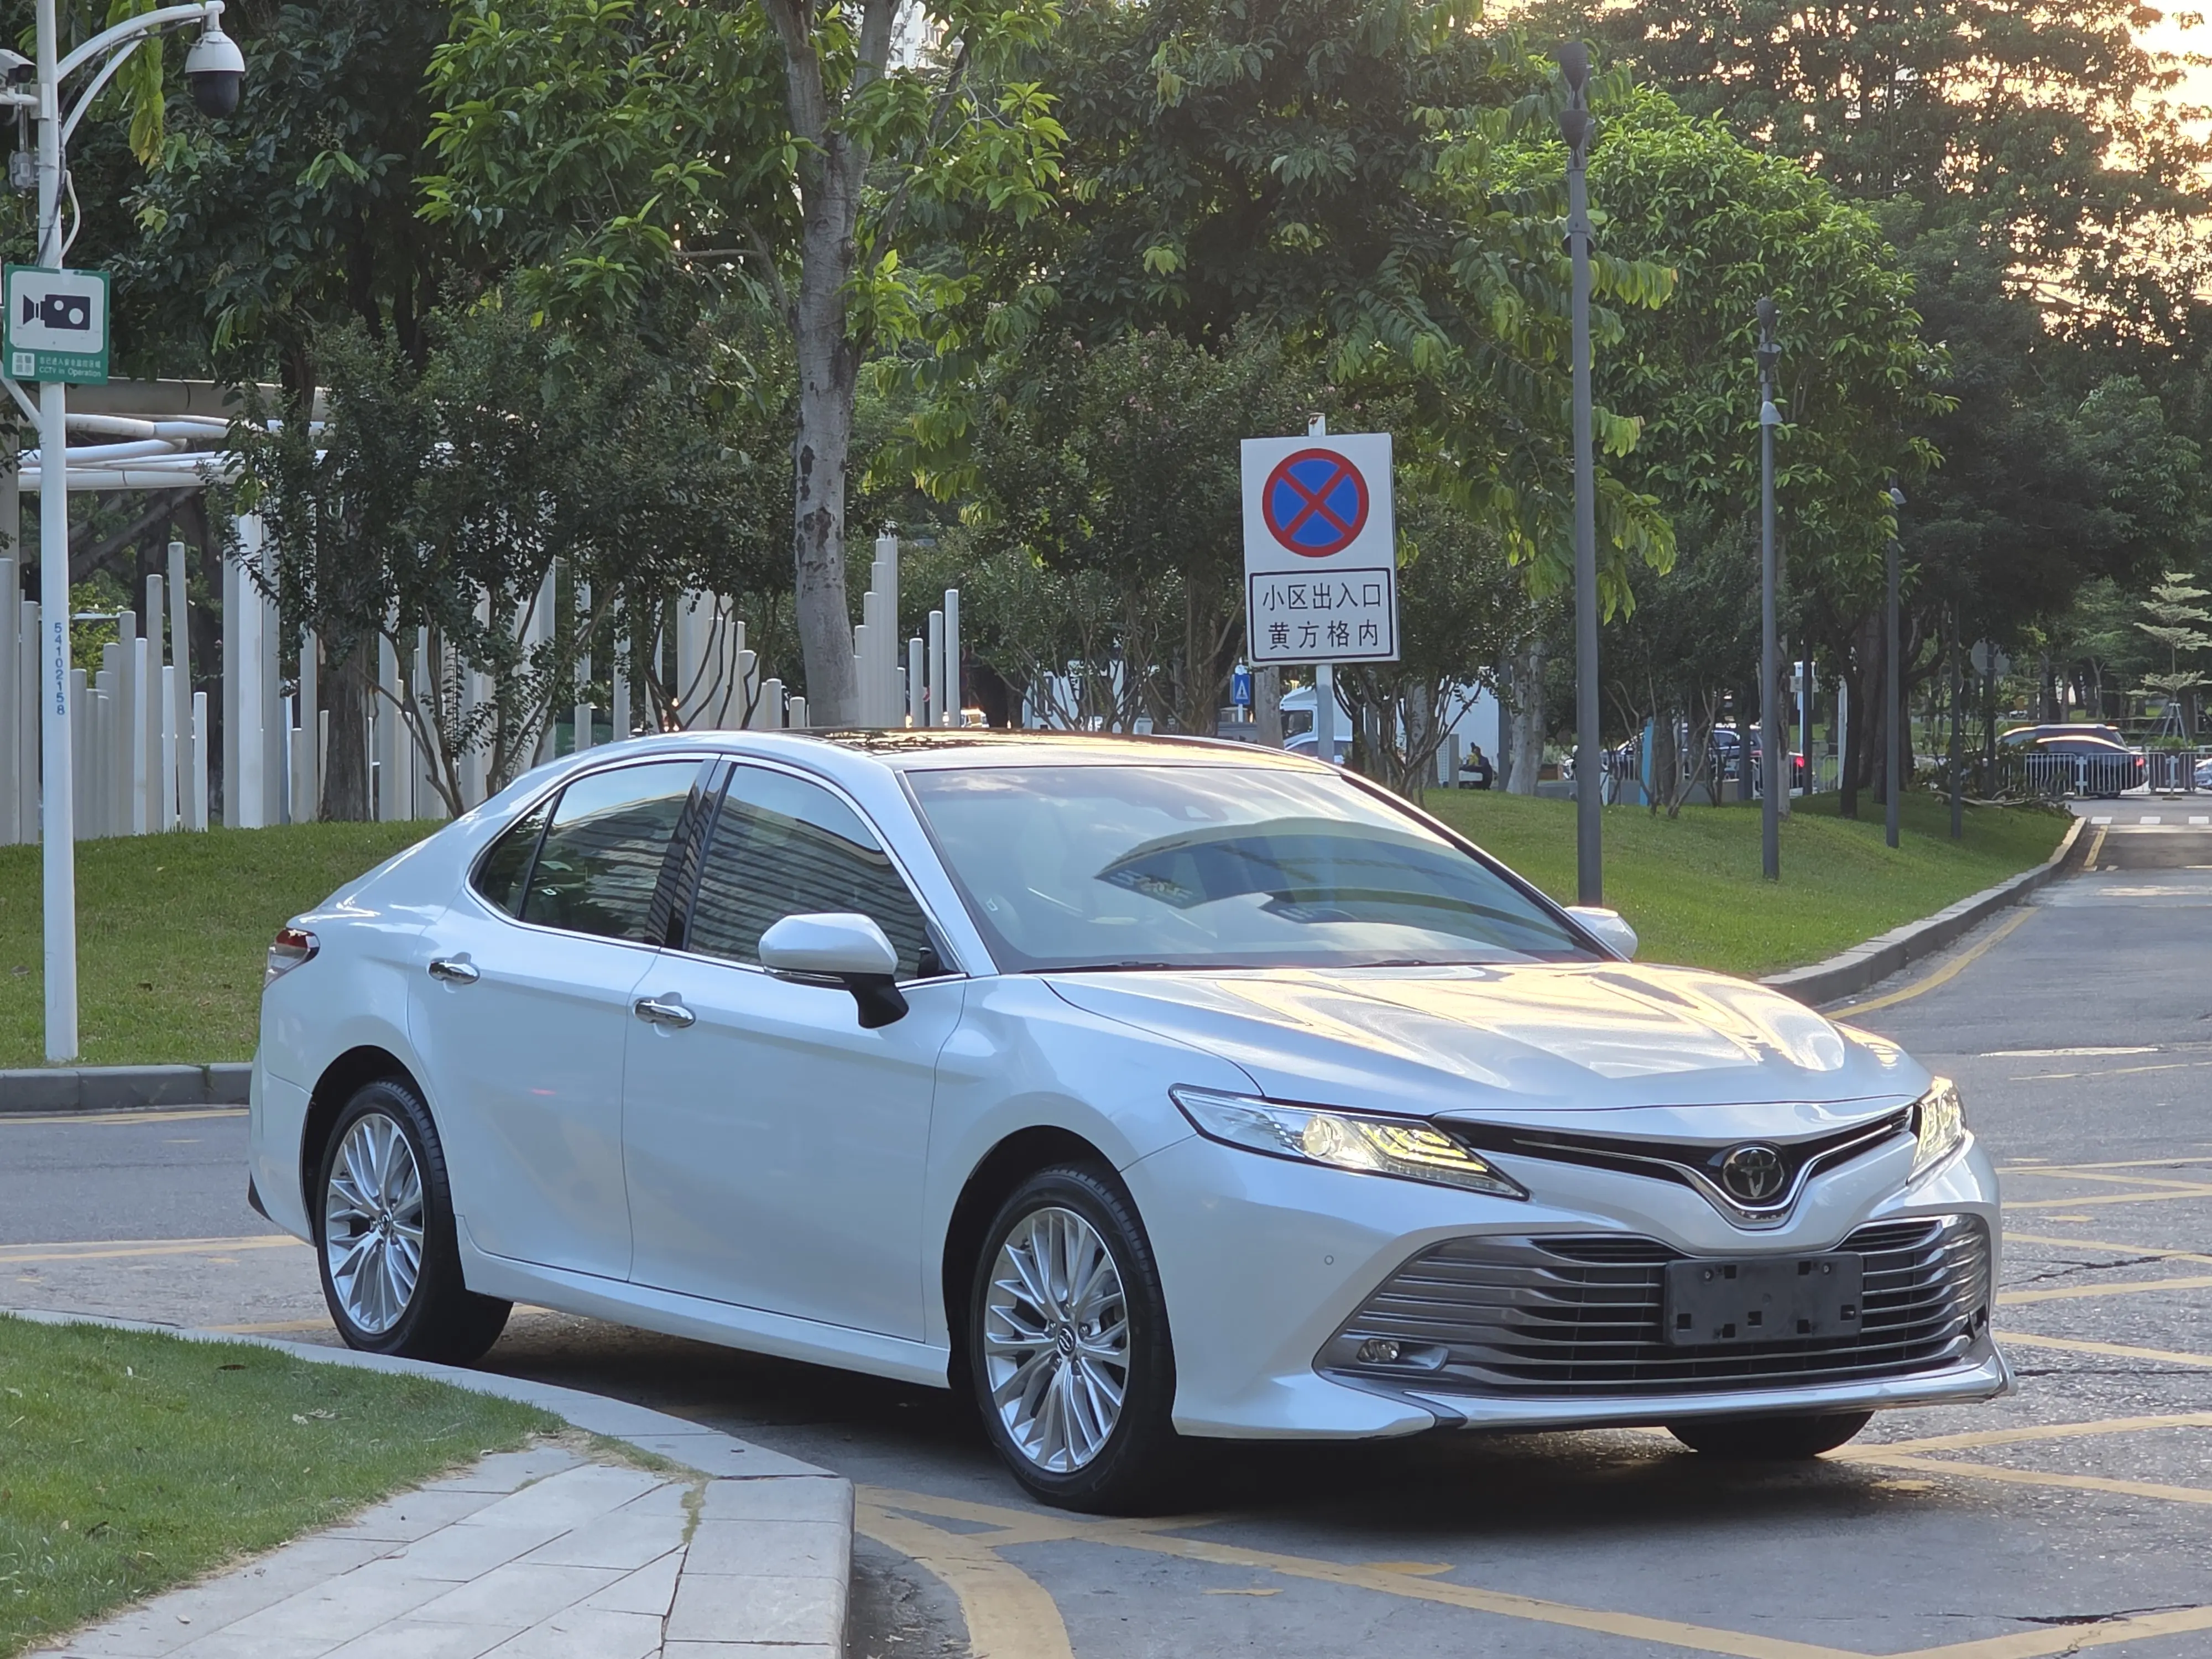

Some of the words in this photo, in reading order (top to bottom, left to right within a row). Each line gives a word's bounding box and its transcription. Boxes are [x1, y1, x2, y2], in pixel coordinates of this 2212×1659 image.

[39, 366, 56, 374] CCTV
[67, 368, 102, 377] Operation
[1262, 582, 1380, 611] 小区出入口
[1268, 619, 1378, 650] 黄方格内
[54, 622, 65, 716] 54102158
